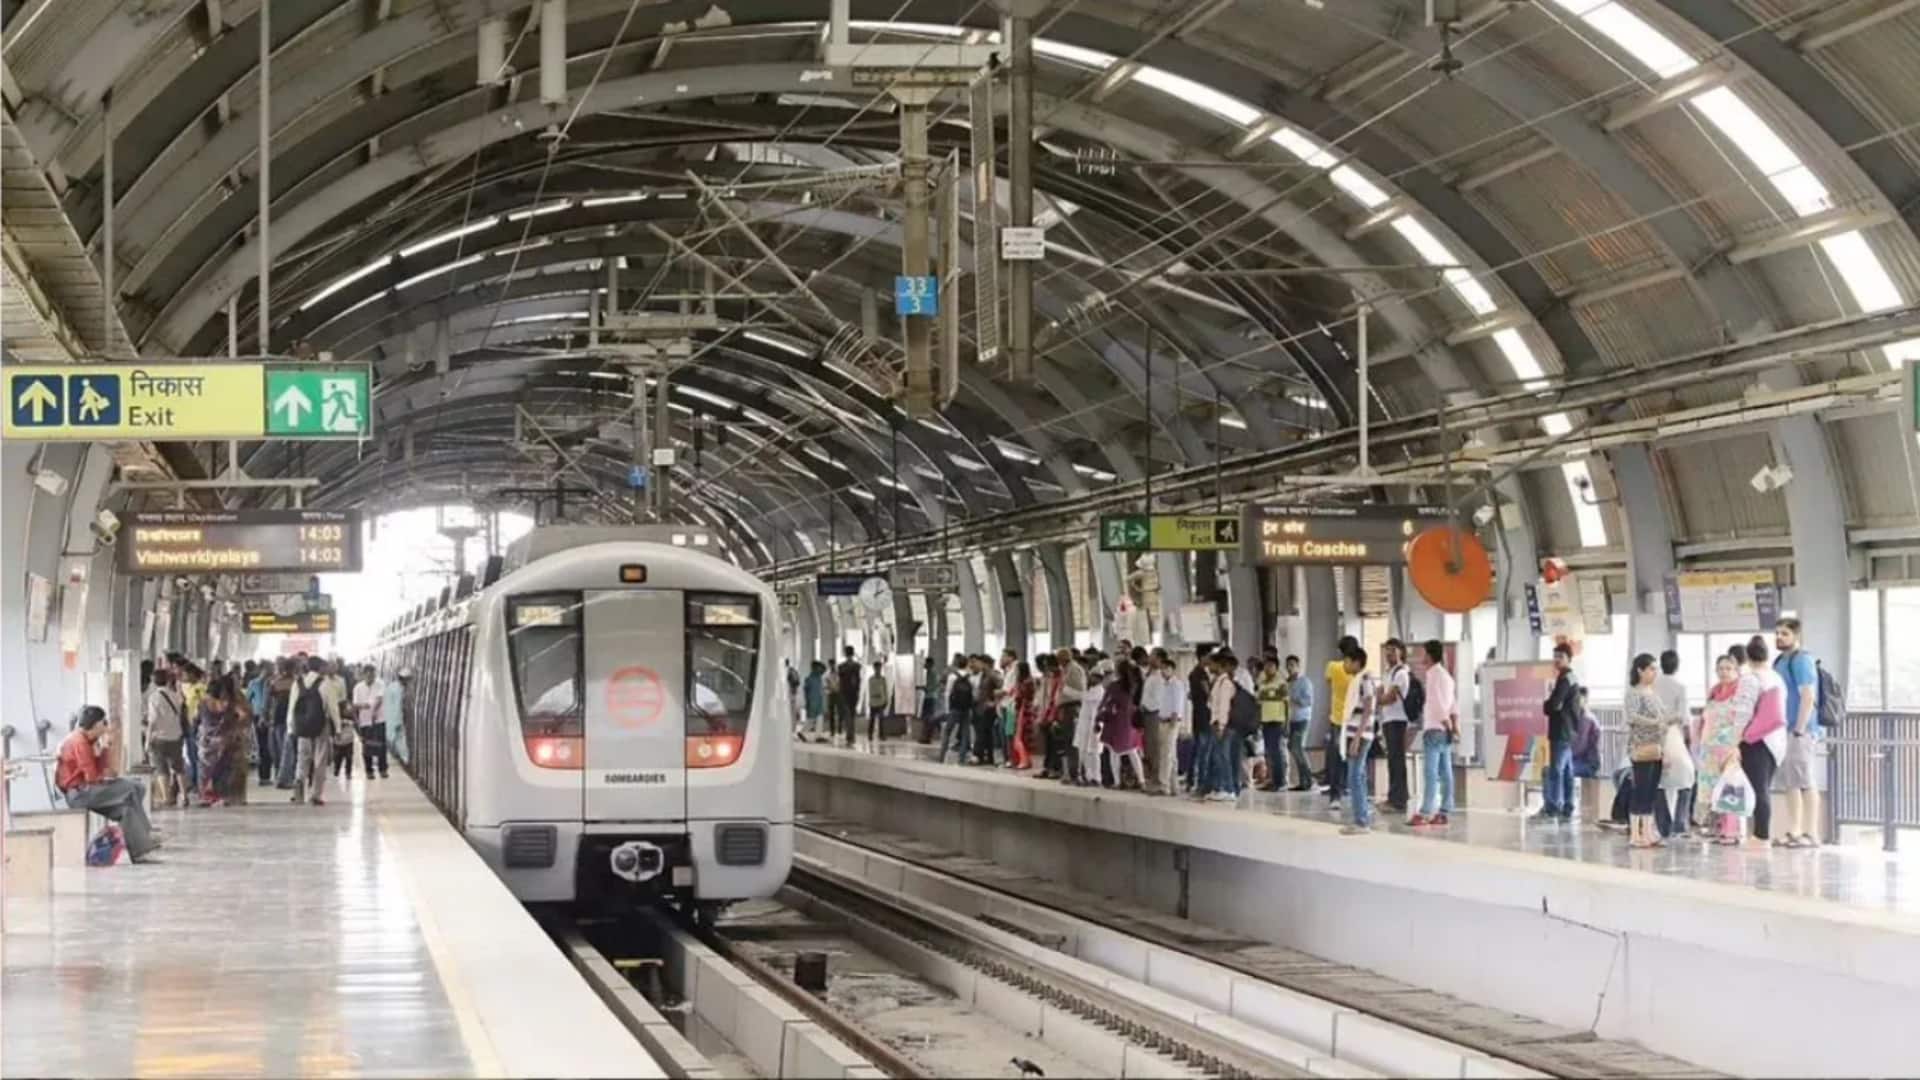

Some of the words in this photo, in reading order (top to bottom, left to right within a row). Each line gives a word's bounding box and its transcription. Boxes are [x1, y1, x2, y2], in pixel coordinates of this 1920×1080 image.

[905, 277, 928, 296] 33
[911, 296, 921, 313] 3
[130, 370, 205, 397] निकास
[129, 406, 175, 426] Exit
[301, 525, 341, 540] 14:03
[1190, 533, 1212, 544] Exit
[301, 548, 341, 562] 14:03
[1263, 540, 1299, 556] Train
[1303, 540, 1367, 556] Coaches
